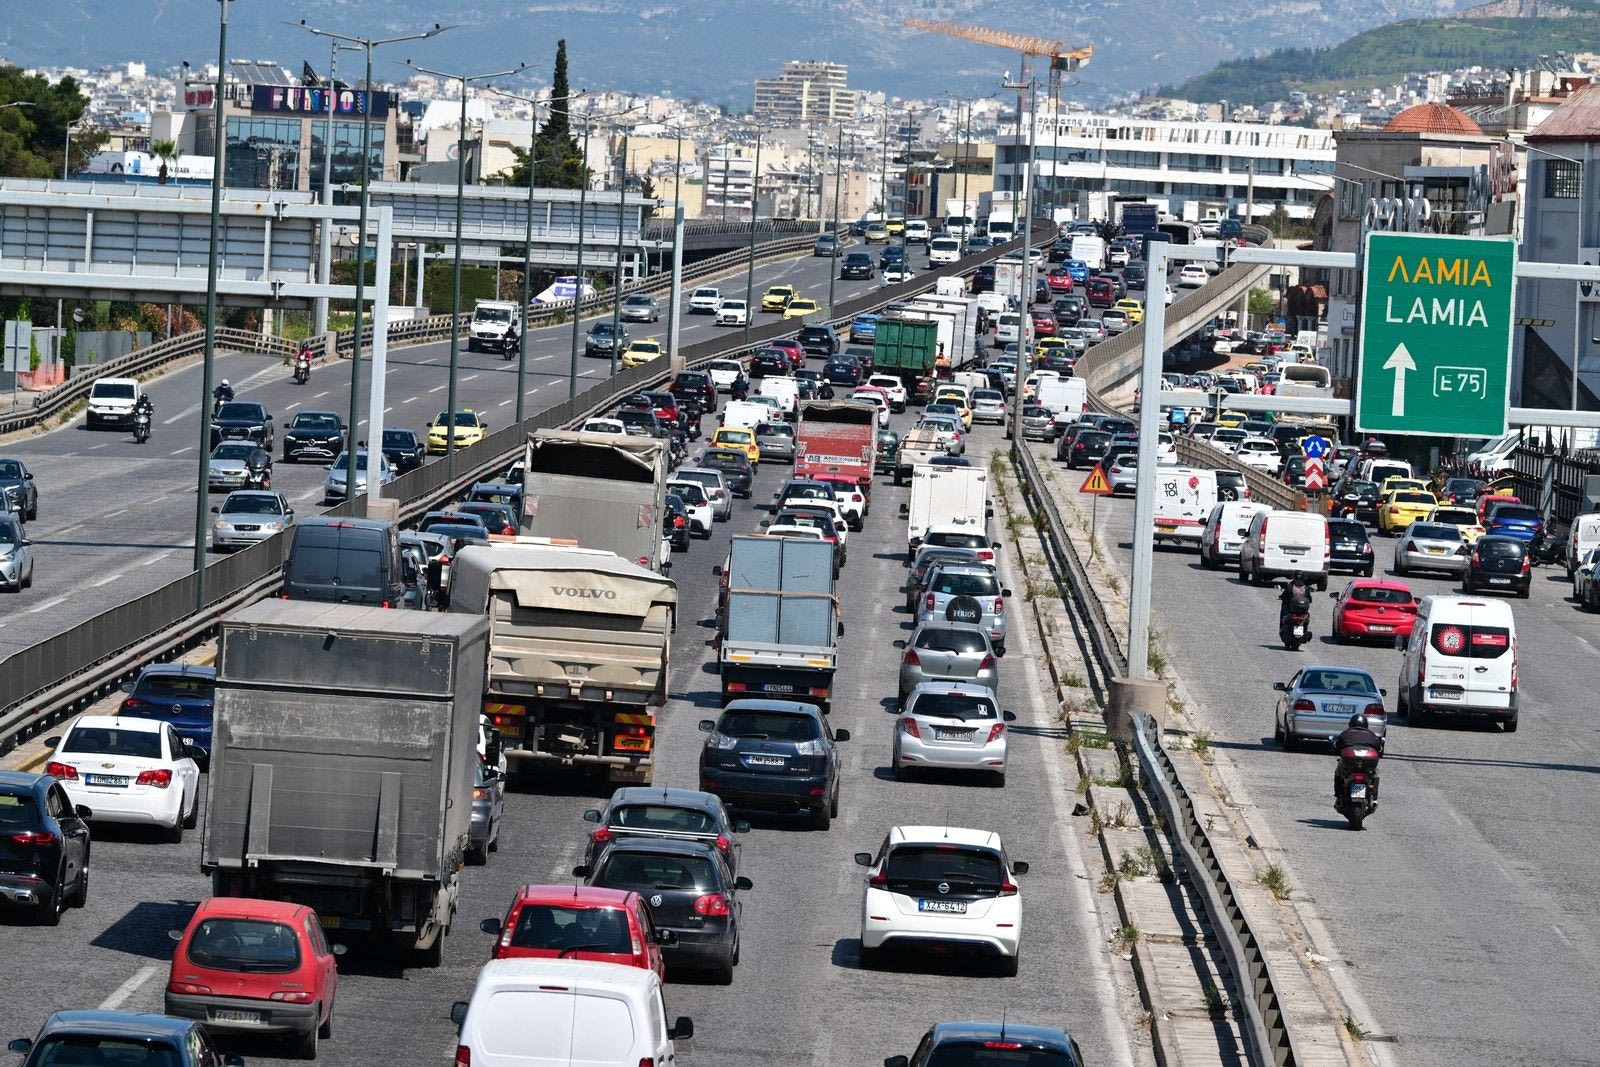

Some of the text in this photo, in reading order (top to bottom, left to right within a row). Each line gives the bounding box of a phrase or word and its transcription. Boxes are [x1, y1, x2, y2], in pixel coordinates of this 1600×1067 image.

[1387, 255, 1492, 287] ΛΑΜΙΑ
[1385, 295, 1489, 328] LAMIA
[1457, 373, 1481, 393] 75
[550, 586, 617, 600] VOLVO
[953, 609, 976, 618] TERIOS
